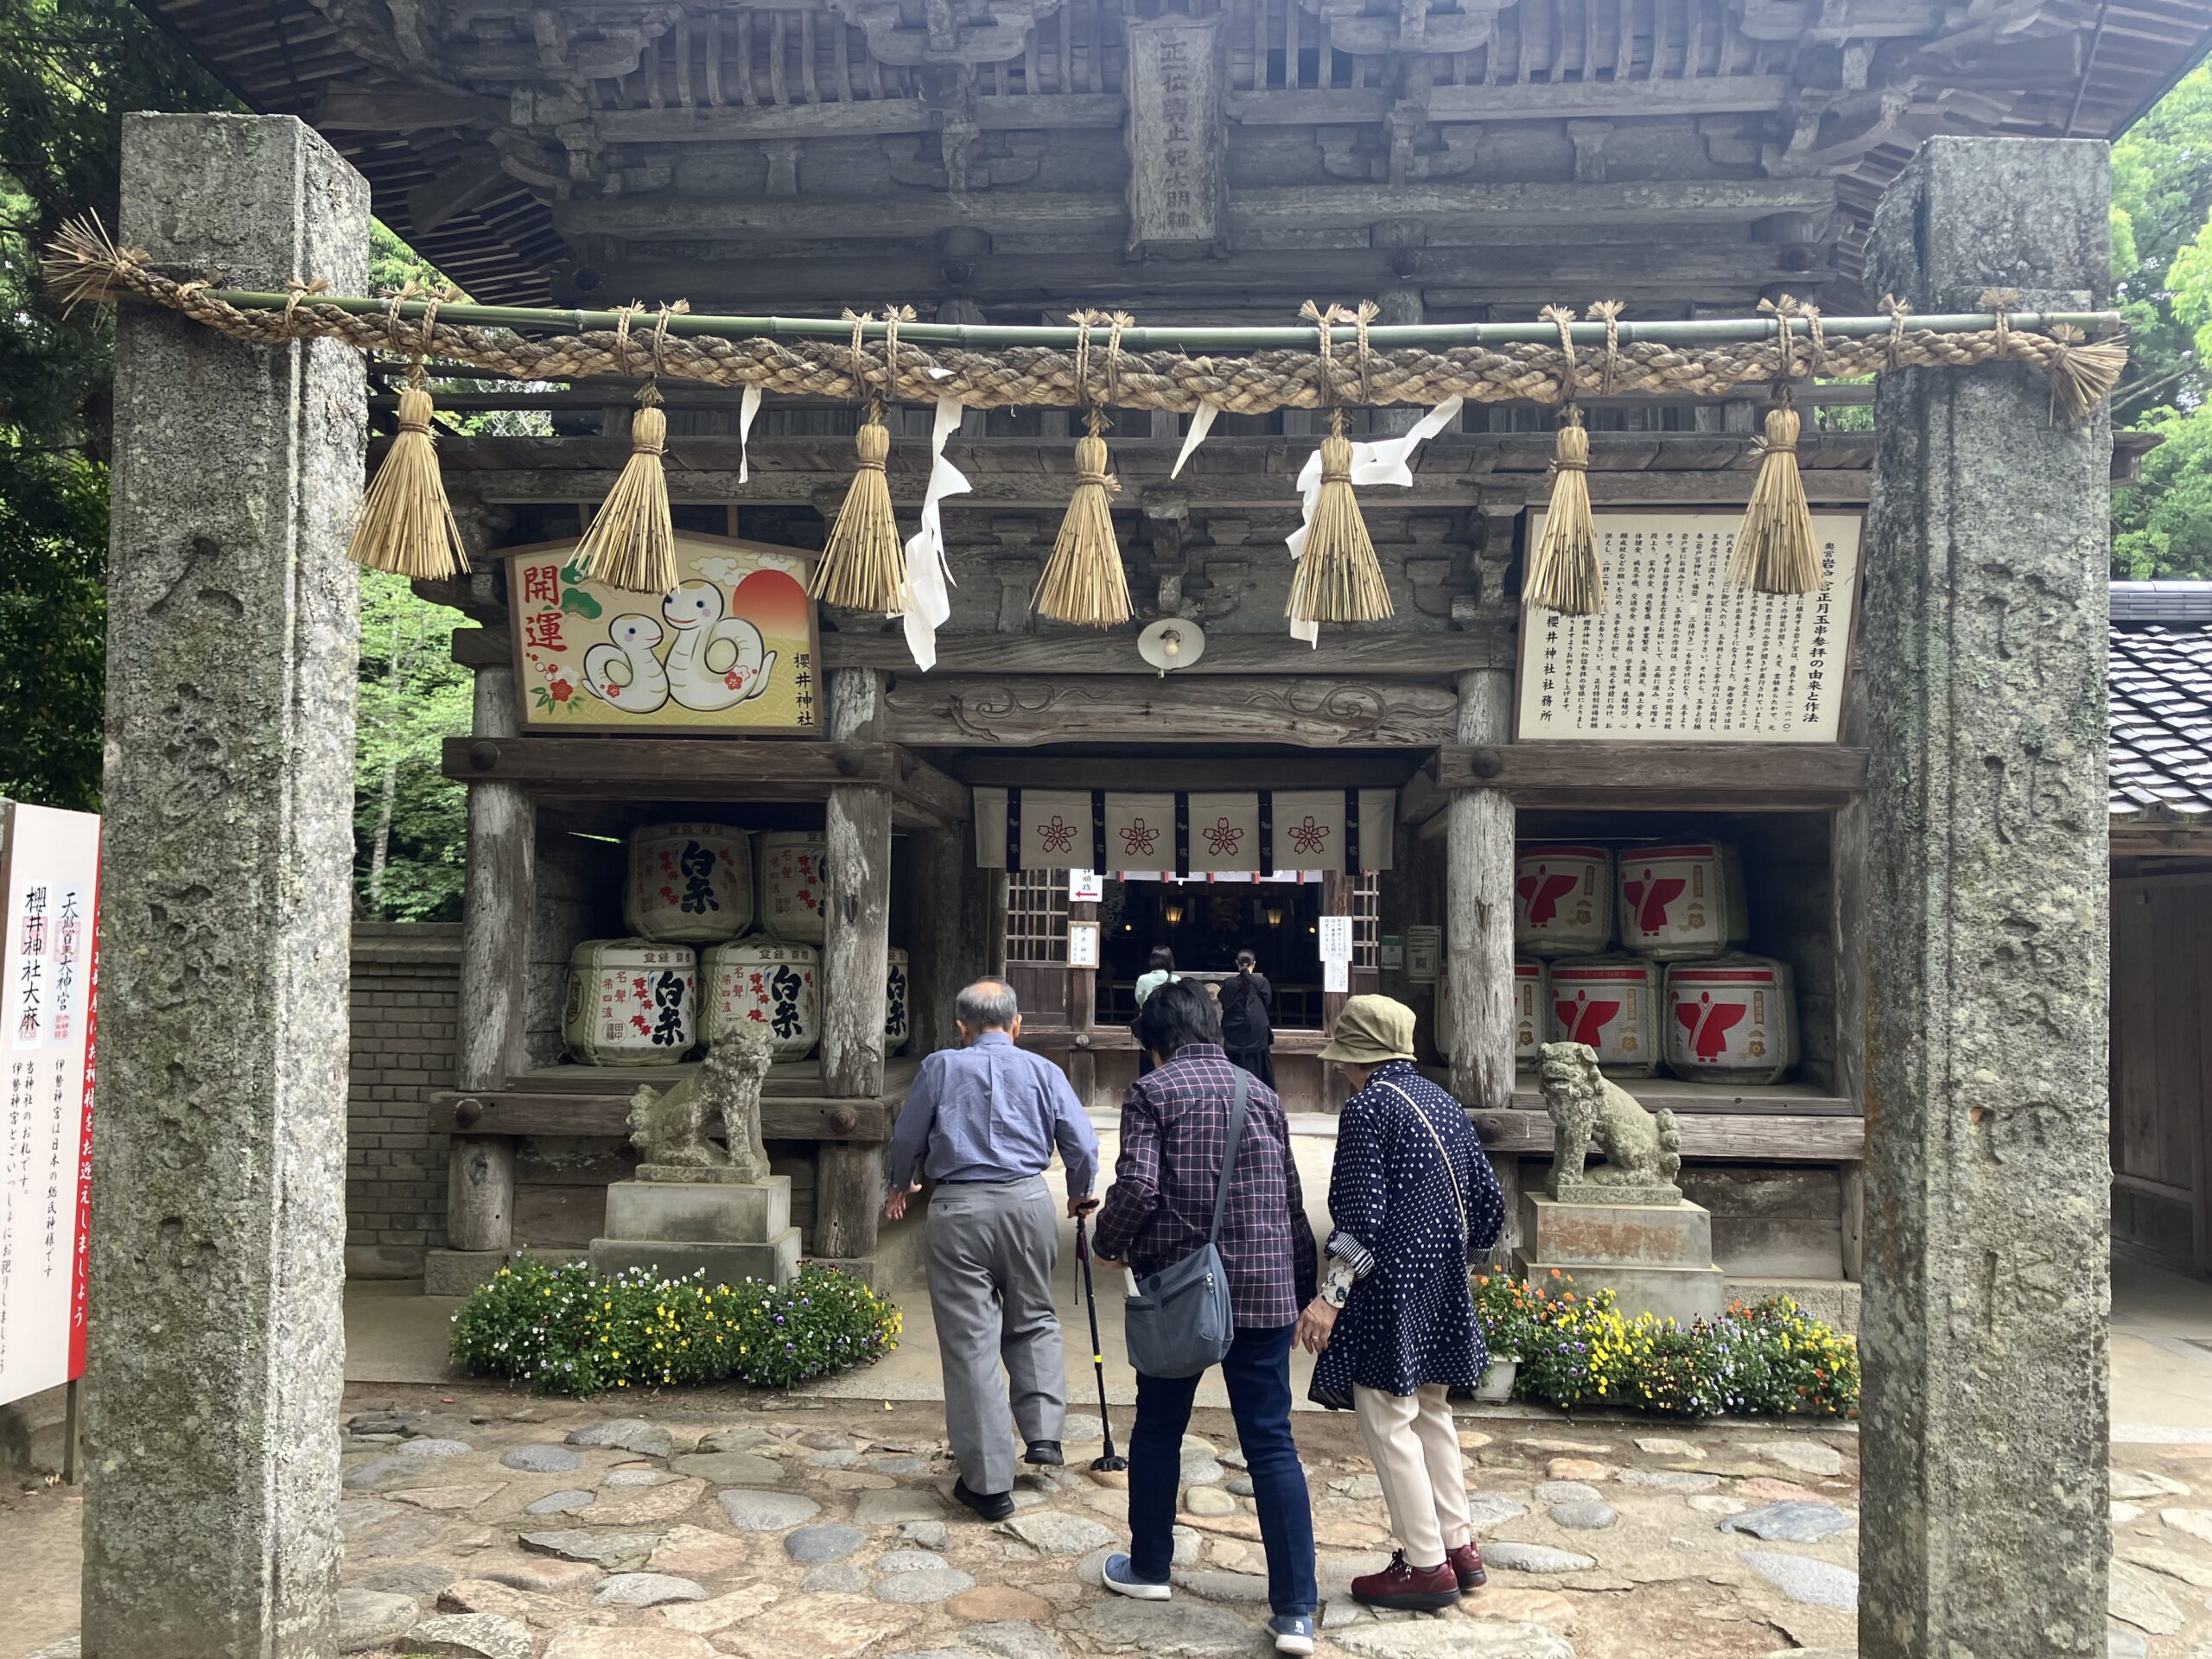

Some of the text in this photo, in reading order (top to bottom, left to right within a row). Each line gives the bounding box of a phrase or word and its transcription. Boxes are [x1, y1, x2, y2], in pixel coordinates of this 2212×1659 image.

[524, 565, 568, 652] 開運
[793, 652, 815, 727] 櫻井神社
[1540, 615, 1560, 722] 櫻井神社社務所
[19, 887, 47, 1033] 櫻井神社大麻
[56, 892, 79, 1012] 天照皇大神宮
[652, 969, 685, 1046] 白糸
[771, 964, 802, 1039] 白糸
